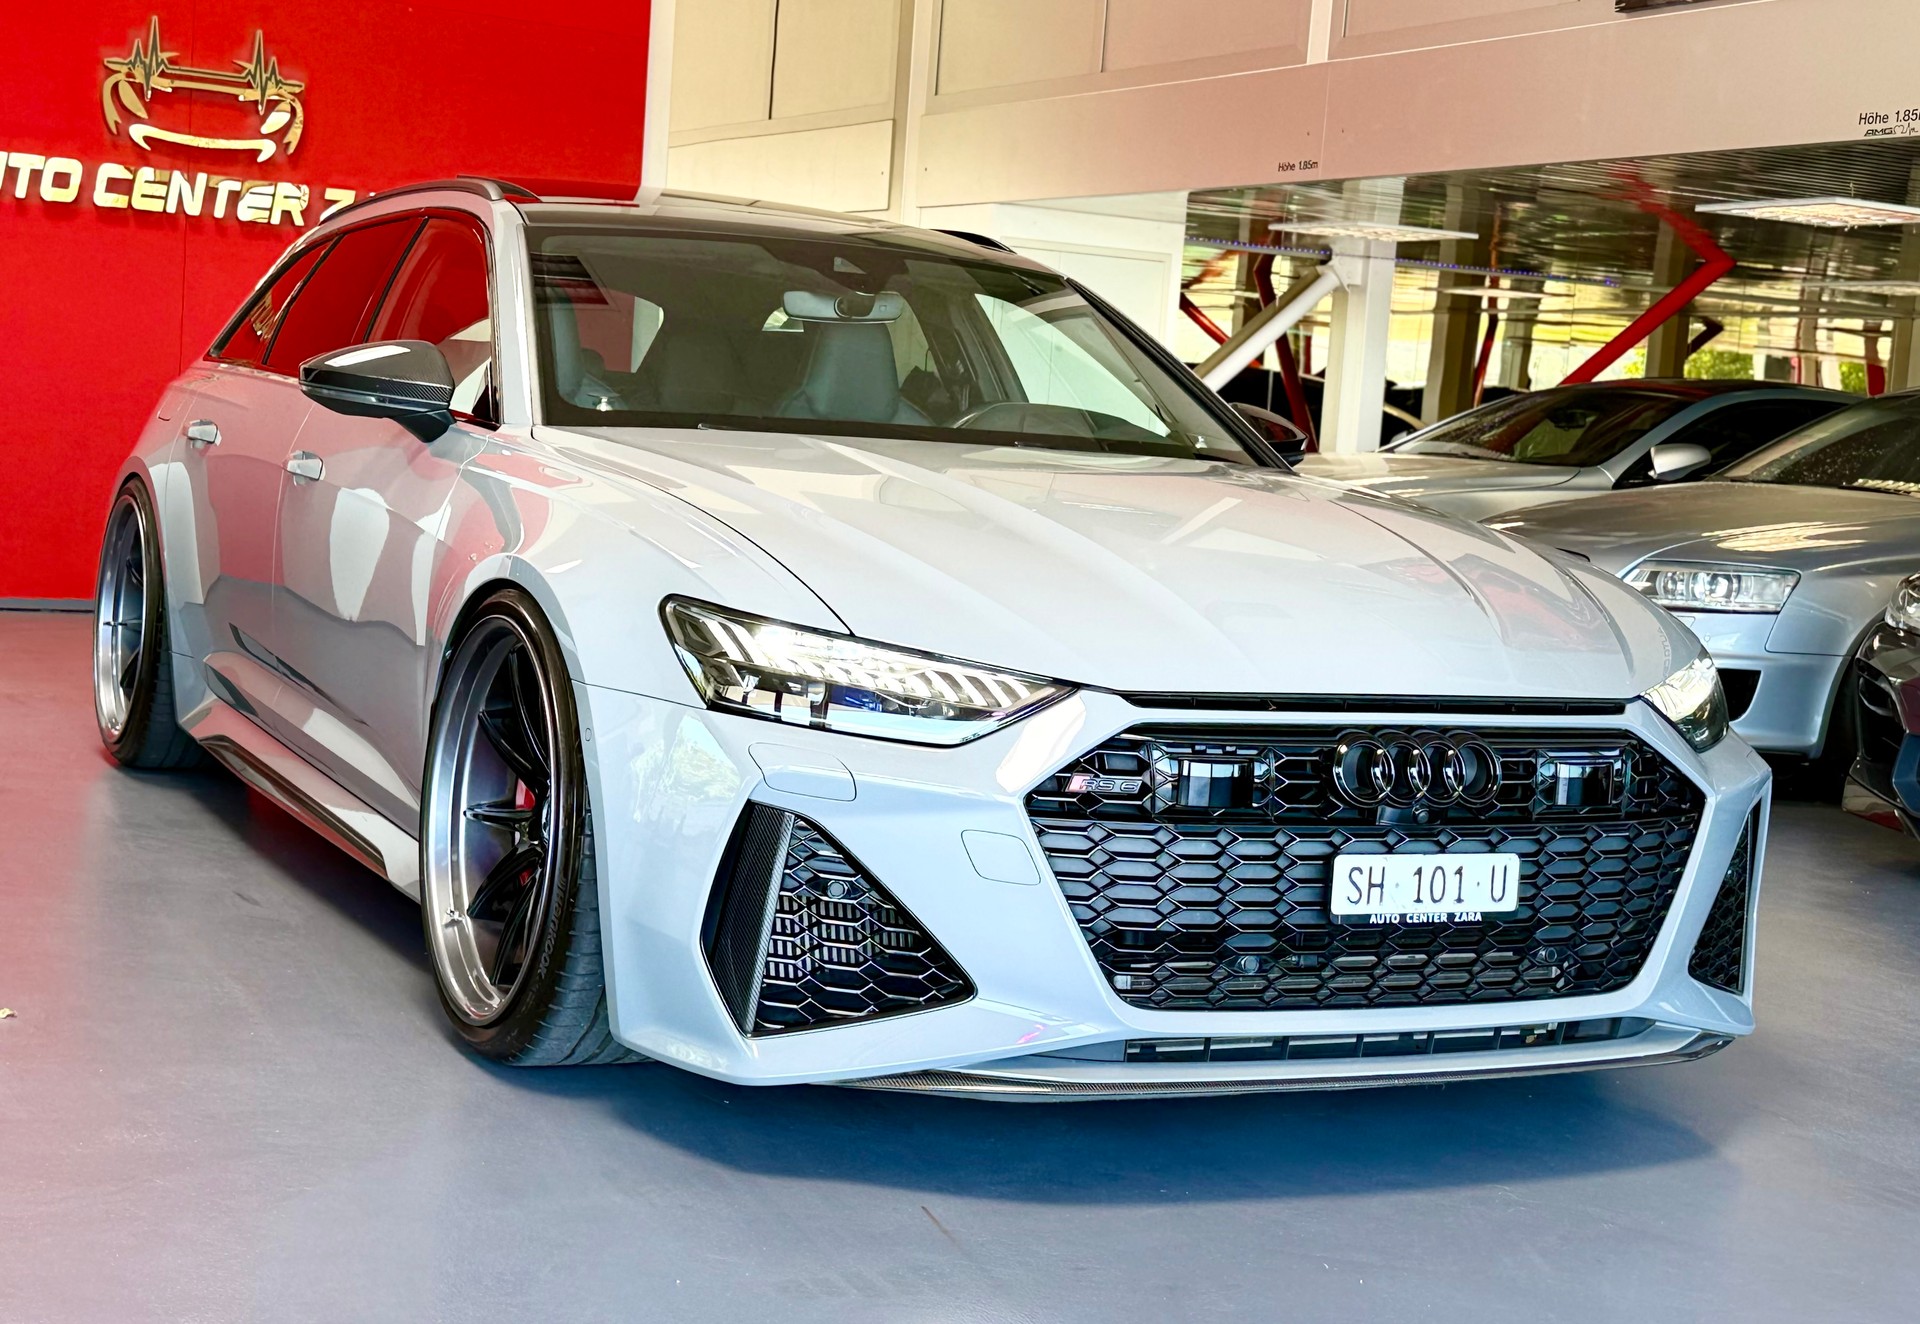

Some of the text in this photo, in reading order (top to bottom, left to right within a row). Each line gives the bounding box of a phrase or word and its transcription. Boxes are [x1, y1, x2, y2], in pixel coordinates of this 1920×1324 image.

[1858, 108, 1920, 126] Höhe 1.85
[0, 151, 83, 203] TO
[93, 162, 310, 227] CENTER
[1347, 864, 1508, 905] SH 101 U
[1369, 911, 1483, 924] AUTO CENTER ZARA
